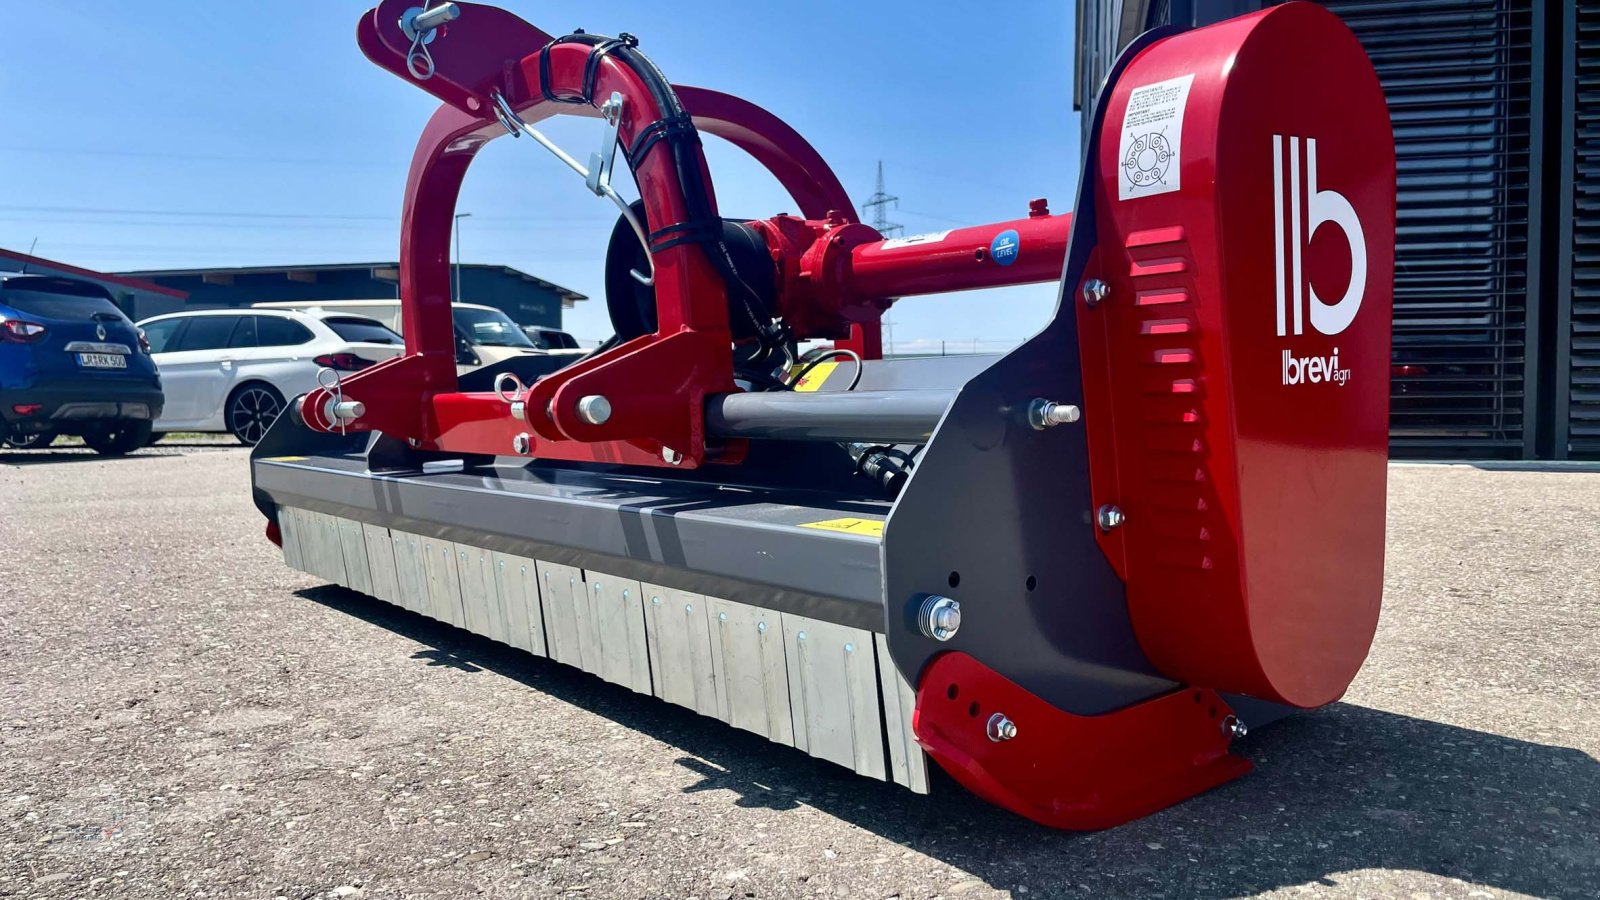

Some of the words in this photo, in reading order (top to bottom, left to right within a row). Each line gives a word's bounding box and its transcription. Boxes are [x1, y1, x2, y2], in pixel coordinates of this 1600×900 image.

[997, 248, 1013, 258] LEVEL
[81, 354, 93, 365] LR
[110, 356, 126, 366] 500
[1333, 369, 1351, 387] agri
